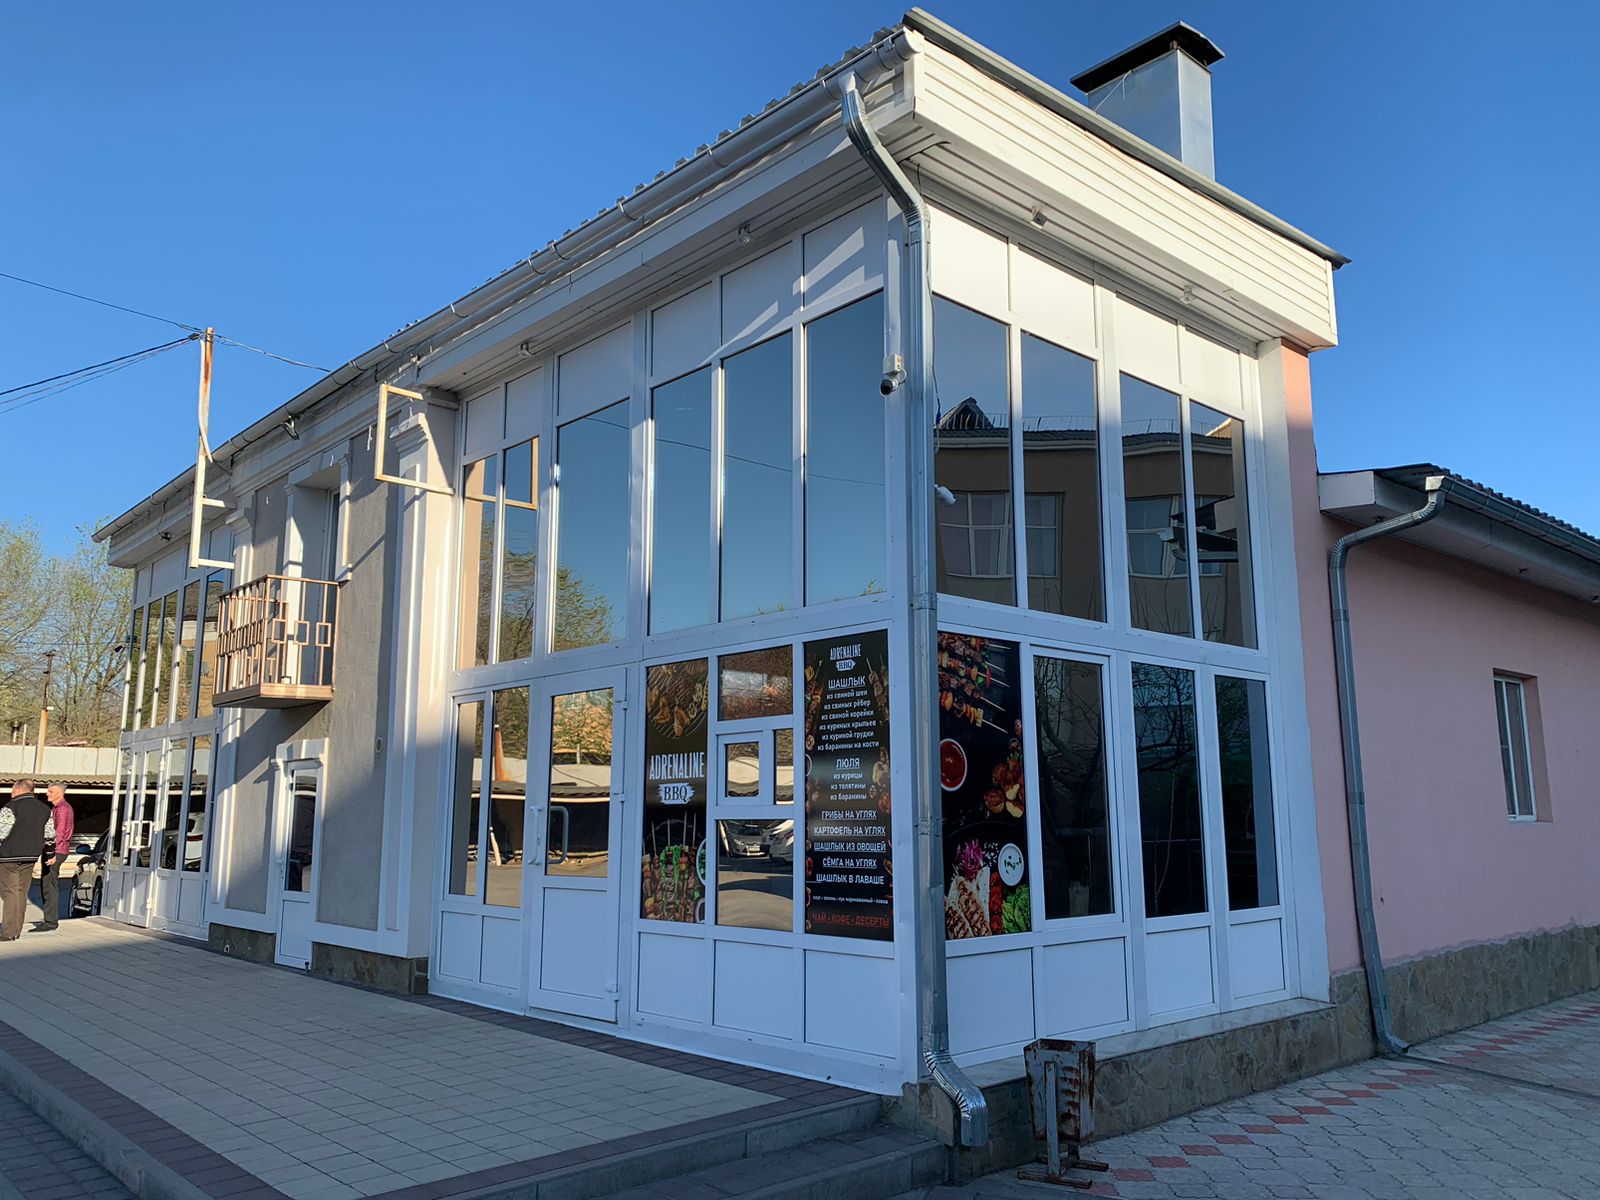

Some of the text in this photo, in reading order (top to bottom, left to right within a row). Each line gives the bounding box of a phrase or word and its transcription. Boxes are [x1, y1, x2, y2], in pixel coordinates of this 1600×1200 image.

[830, 644, 861, 660] ADRENALINE
[838, 662, 853, 670] BBQ
[828, 676, 866, 689] ШАШЛЫК
[834, 690, 854, 699] свиной
[832, 701, 852, 709] свиных
[829, 710, 849, 719] свиной
[850, 709, 874, 718] корейки
[827, 722, 850, 731] куриных
[851, 720, 876, 729] крыльев
[829, 731, 853, 741] куриной
[853, 731, 874, 740] грудки
[825, 743, 853, 751] баранины
[649, 752, 704, 780] ADRENALINE
[836, 757, 860, 769] ЛЮЛЯ
[841, 772, 863, 781] курицы
[664, 785, 688, 803] BBQ
[838, 793, 867, 802] баранины
[821, 810, 877, 819] ГРИБЫ НА УГЛЯХ
[813, 826, 886, 835] КАРТОФЕЛЬ НА УГЛЯХ
[813, 841, 886, 852] ШАШЛЫК ИЗ ОВОЩЕЙ
[822, 856, 877, 868] СЁМГА НА УГЛЯХ
[815, 873, 885, 885] ШАШЛЫК В ЛАВАШЕ
[812, 912, 889, 927] ЧАЙ КОФЕ ДЕСЕРТЫ
